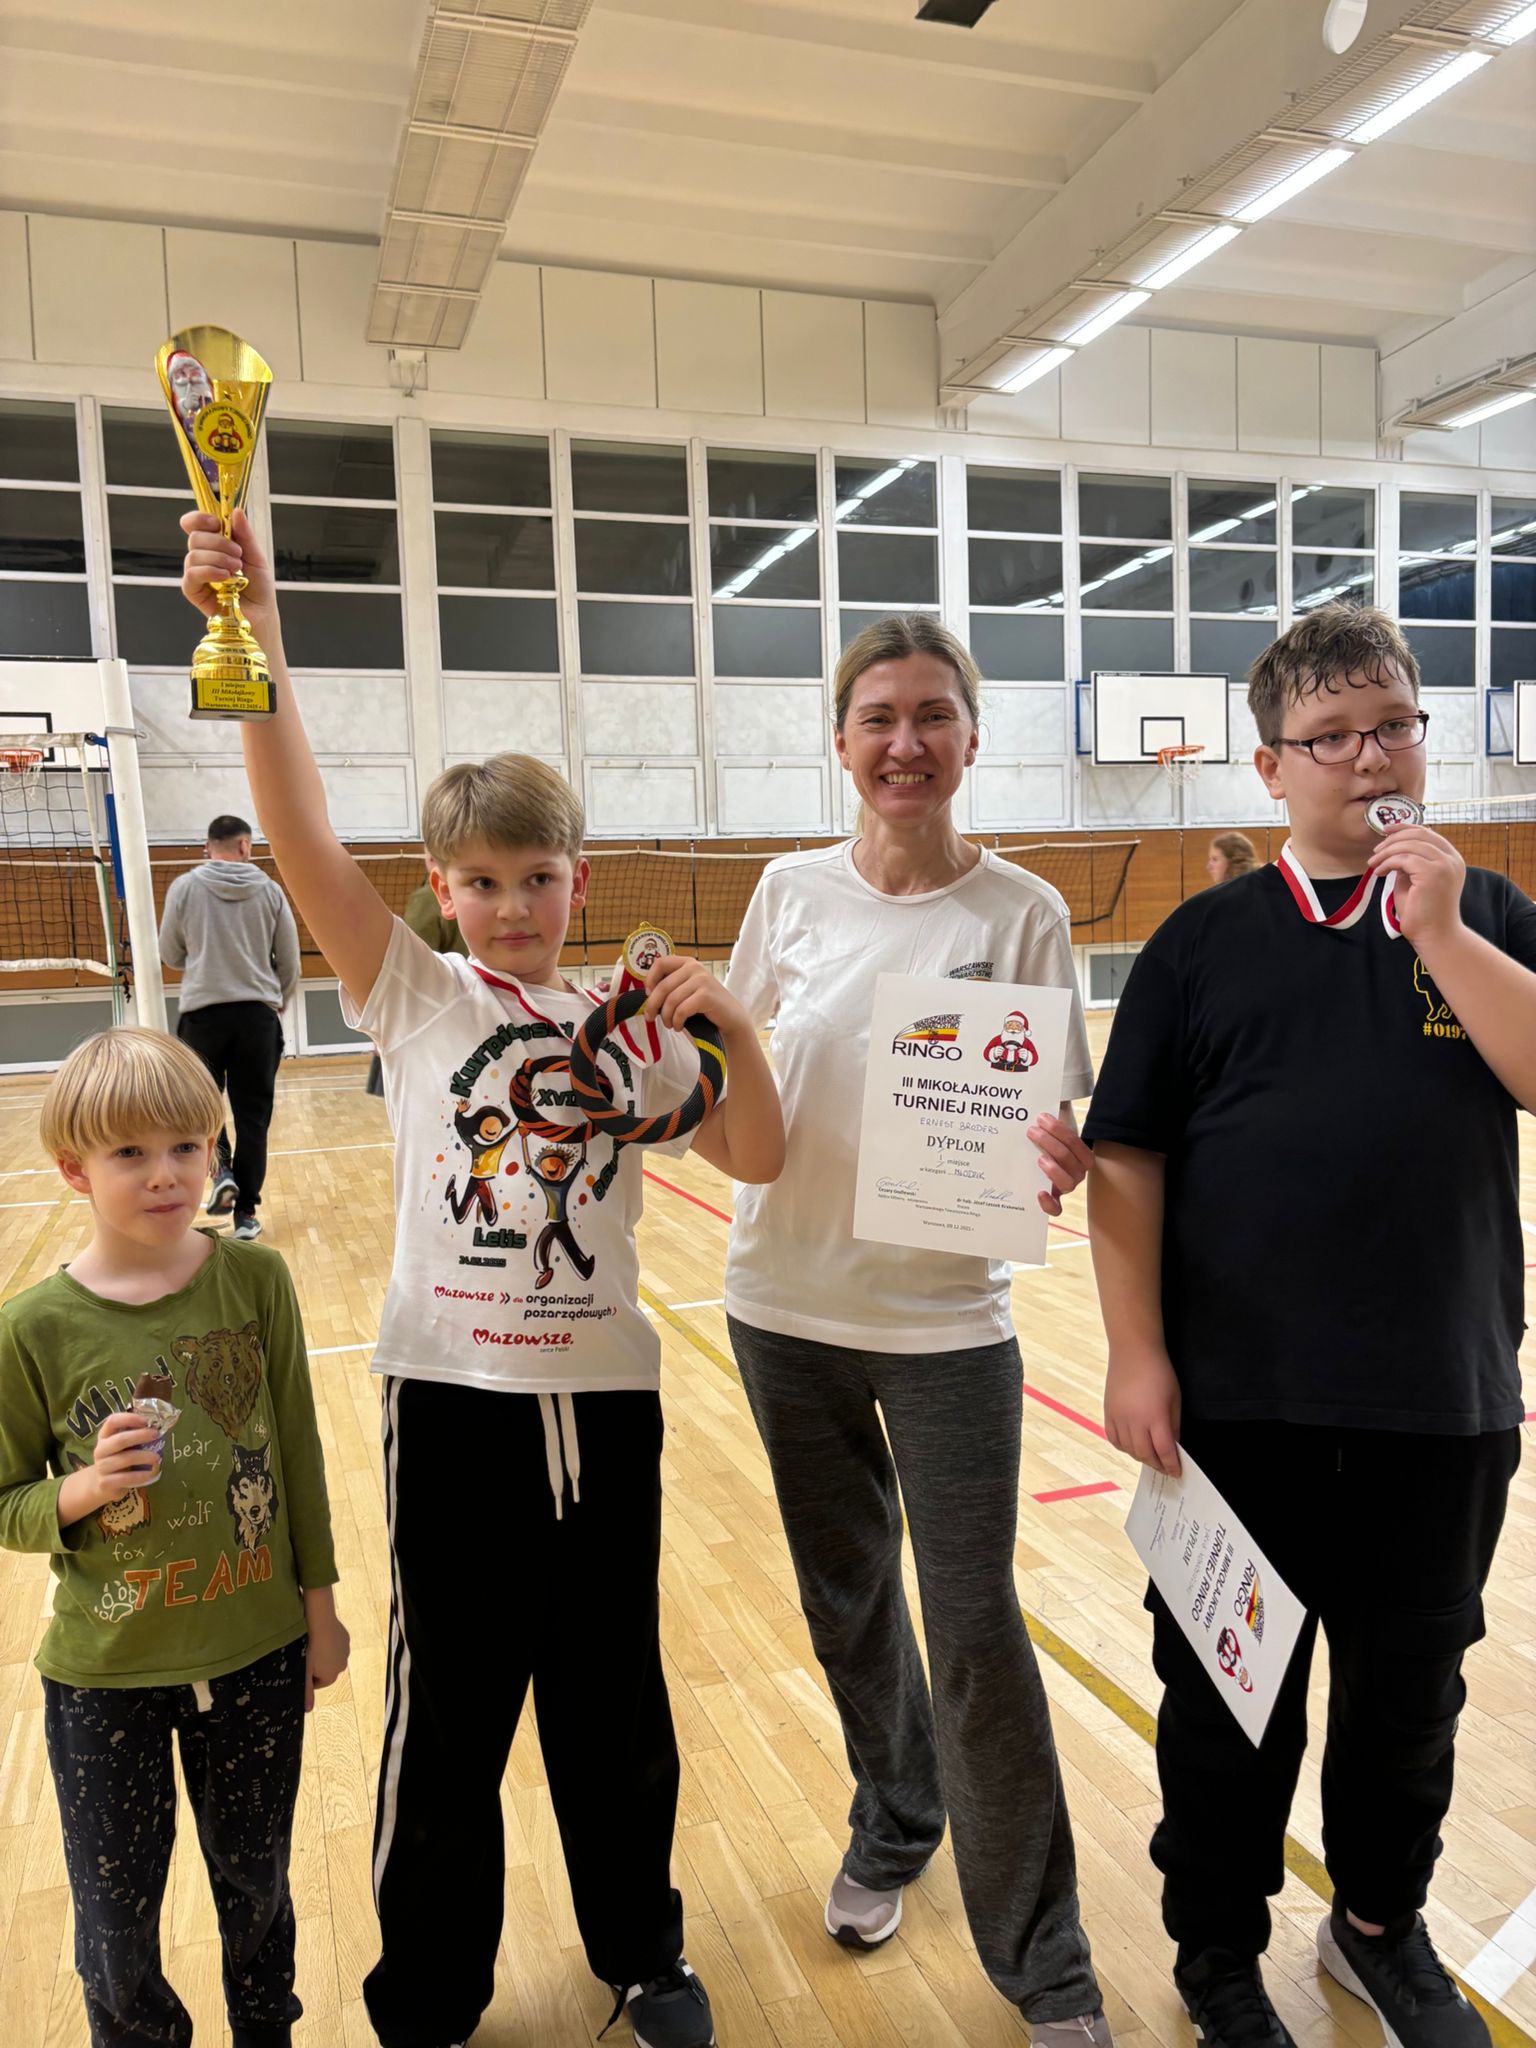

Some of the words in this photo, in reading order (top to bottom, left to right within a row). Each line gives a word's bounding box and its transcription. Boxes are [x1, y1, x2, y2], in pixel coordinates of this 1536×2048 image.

[892, 1040, 962, 1061] RINGO
[902, 1076, 913, 1088] III
[917, 1078, 1023, 1100] MIKOŁAJKOWY
[893, 1093, 966, 1114] TURNIEJ
[970, 1102, 1029, 1121] RINGO
[926, 1135, 985, 1153] DYPLOM
[946, 1158, 970, 1167] miejsce
[434, 1285, 495, 1302] Mazowsze
[526, 1293, 594, 1307] organizacji
[523, 1306, 612, 1321] pozarządowych
[171, 1432, 213, 1464] bear
[167, 1500, 213, 1530] wolf
[112, 1542, 144, 1562] fox
[1205, 1522, 1226, 1581] TURNIEJ
[124, 1544, 272, 1612] TEAM
[1234, 1558, 1257, 1617] RINGO
[1192, 1576, 1210, 1621] RINGO
